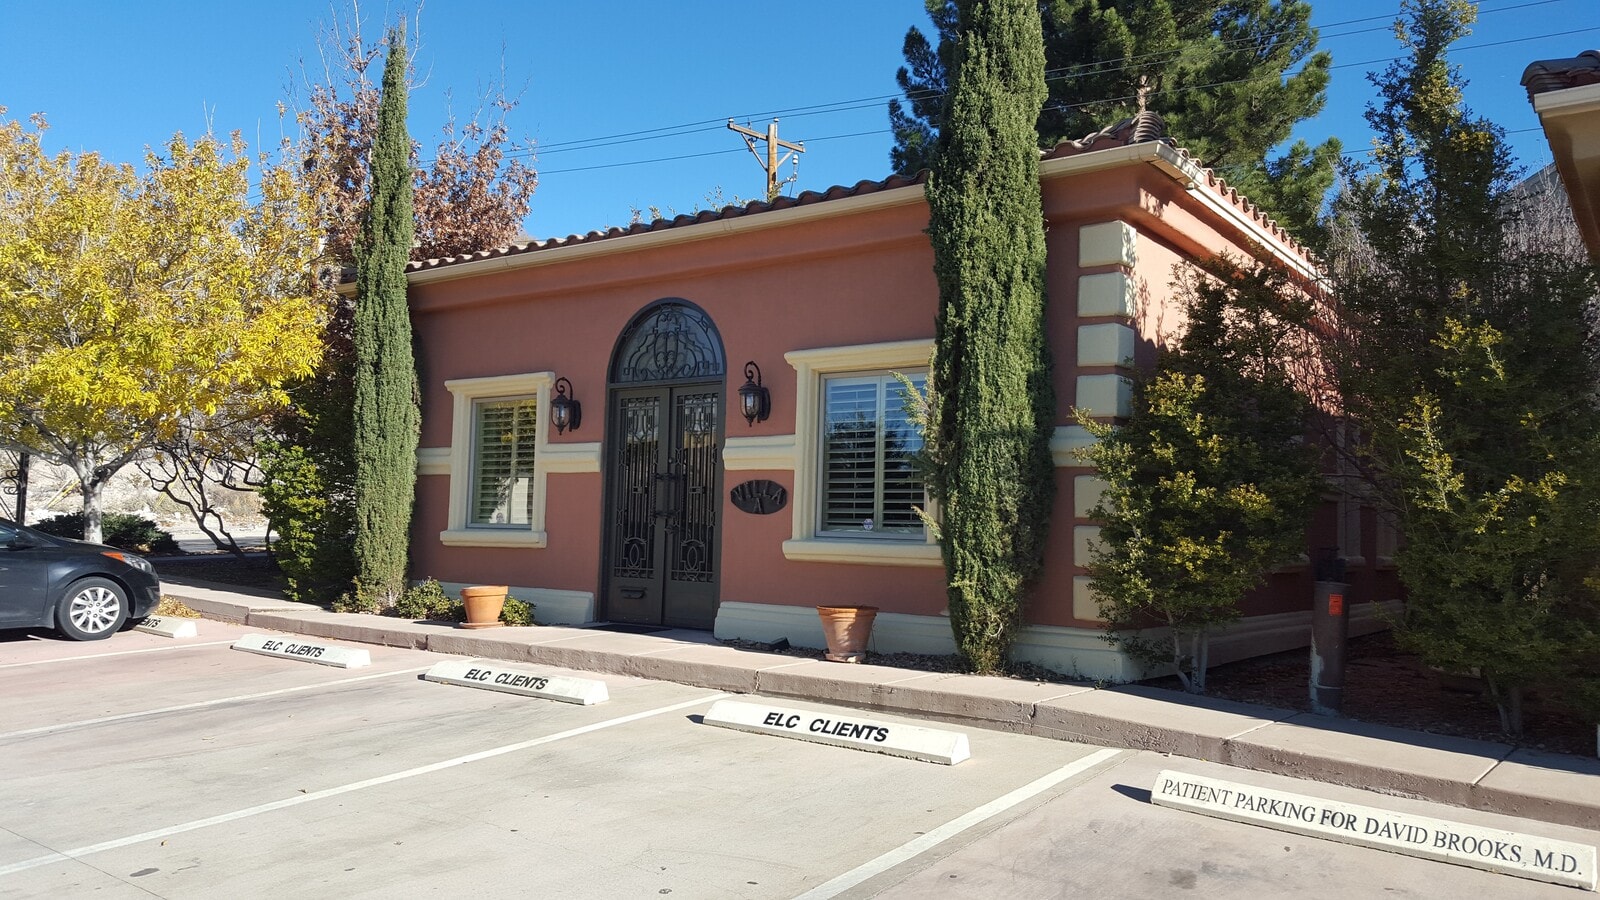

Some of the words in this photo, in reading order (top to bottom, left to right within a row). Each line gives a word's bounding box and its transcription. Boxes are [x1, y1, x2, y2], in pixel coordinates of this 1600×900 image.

[261, 640, 283, 651] ELC
[284, 643, 325, 658] CLIENTS
[464, 668, 492, 681] ELC
[494, 673, 549, 690] CLIENTS
[763, 712, 801, 729] ELC
[809, 719, 889, 742] CLIENTS
[1161, 779, 1232, 805] PATIENT
[1234, 792, 1316, 823] PARKING
[1319, 809, 1358, 831] FOR
[1363, 817, 1428, 844] DAVID
[1432, 830, 1527, 867] BROOKS,
[1533, 849, 1582, 875] M.D.
